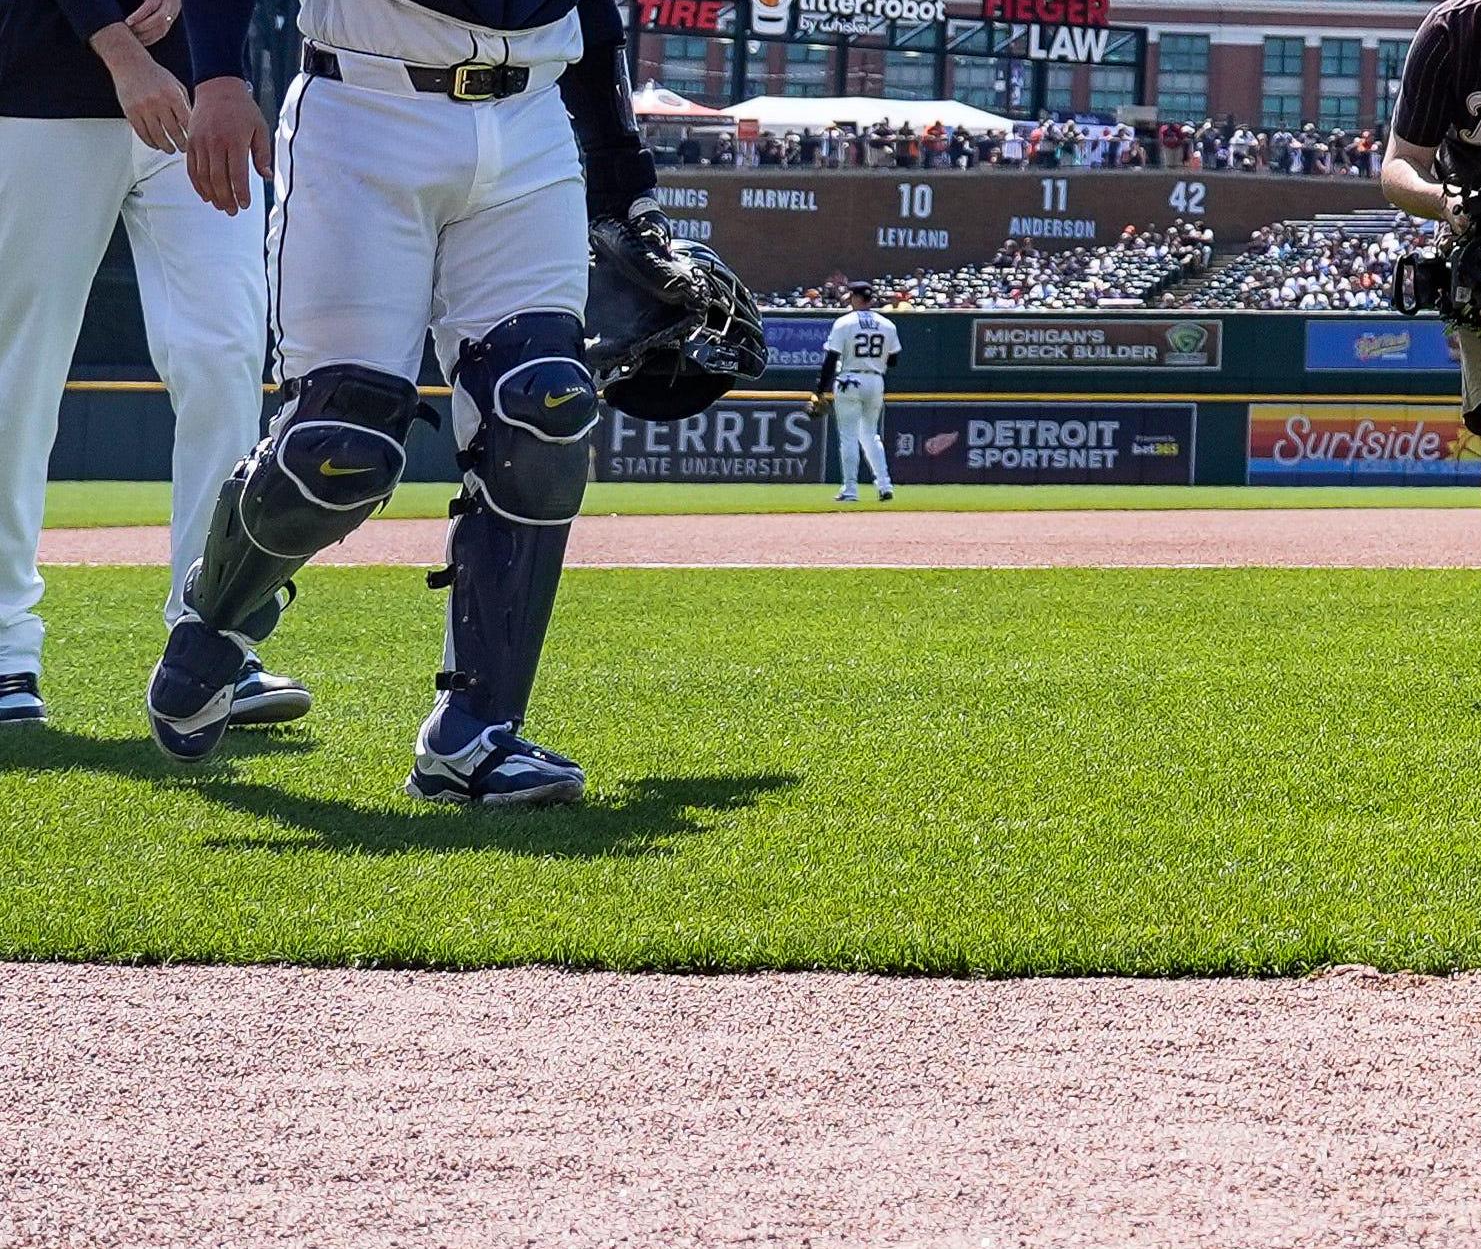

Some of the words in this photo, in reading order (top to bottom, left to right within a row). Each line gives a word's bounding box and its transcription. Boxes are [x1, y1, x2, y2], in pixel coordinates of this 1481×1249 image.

[800, 16, 817, 35] by
[1029, 23, 1110, 63] LAW
[655, 187, 708, 209] NINGS
[740, 188, 818, 211] HARWELL
[897, 182, 933, 218] 10
[1041, 178, 1068, 212] 11
[1168, 181, 1206, 214] 42
[669, 218, 712, 241] FORD
[877, 227, 949, 250] LEYLAND
[1009, 216, 1096, 239] ANDERSON
[854, 333, 885, 358] 28
[983, 328, 1106, 345] MICHIGAN'S
[983, 345, 1008, 360] #1
[1013, 345, 1069, 360] DECK
[1073, 344, 1158, 360] BUILDER
[610, 409, 814, 454] FERRIS
[967, 420, 1121, 448] DETROIT
[1272, 414, 1441, 466] Surfside
[610, 456, 673, 476] STATE
[681, 456, 809, 477] UNIVERSITY
[967, 449, 1119, 469] SPORTSNET
